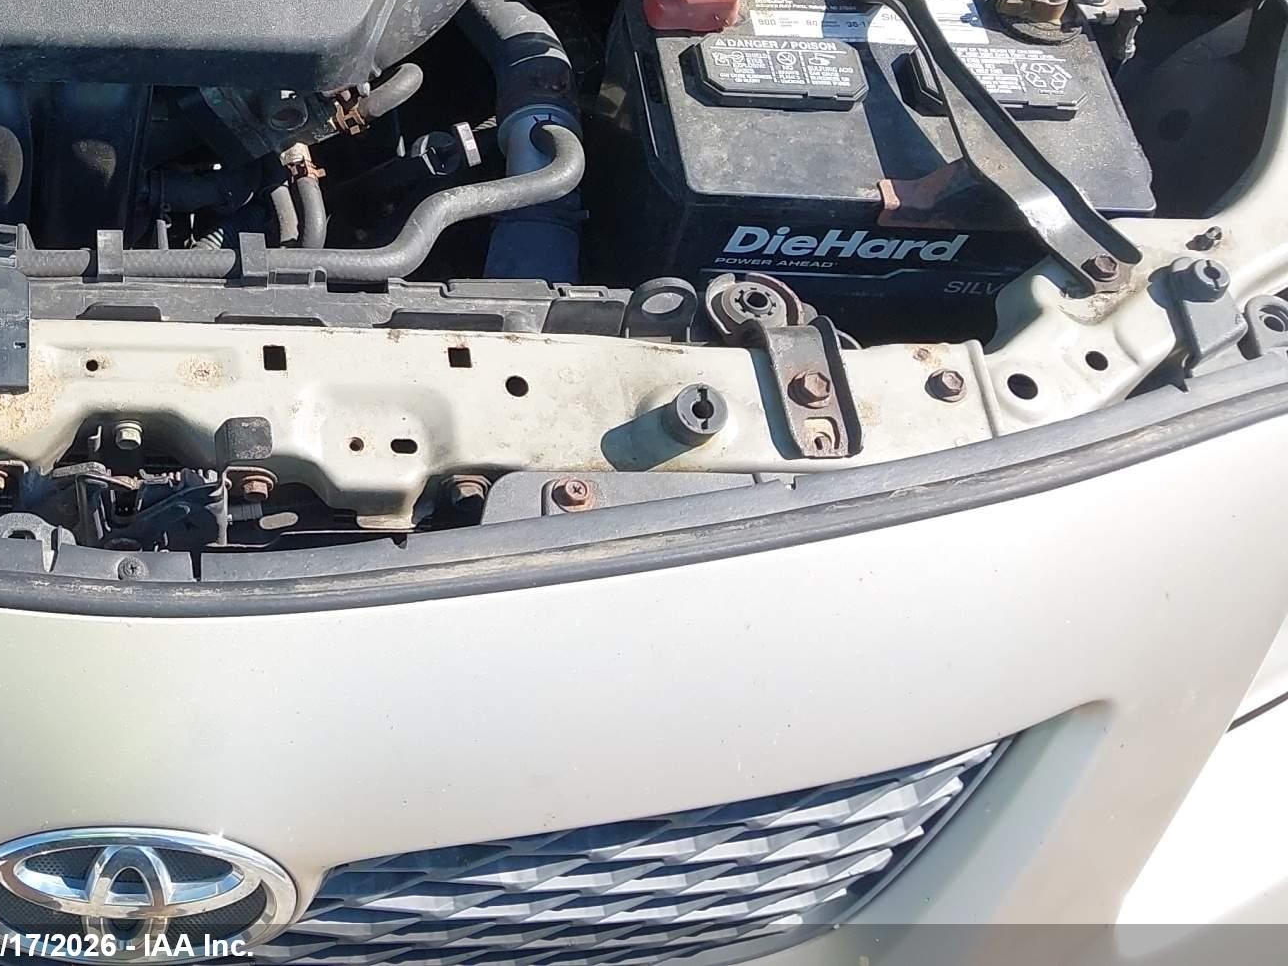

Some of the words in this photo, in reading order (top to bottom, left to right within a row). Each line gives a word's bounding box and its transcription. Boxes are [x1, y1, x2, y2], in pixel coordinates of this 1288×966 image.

[881, 13, 902, 21] SIL
[726, 39, 778, 49] DANGER
[790, 42, 837, 50] POISON
[723, 226, 970, 262] DieHard
[714, 257, 772, 266] POWER
[776, 260, 834, 268] AHEAD
[944, 281, 1005, 295] SILV
